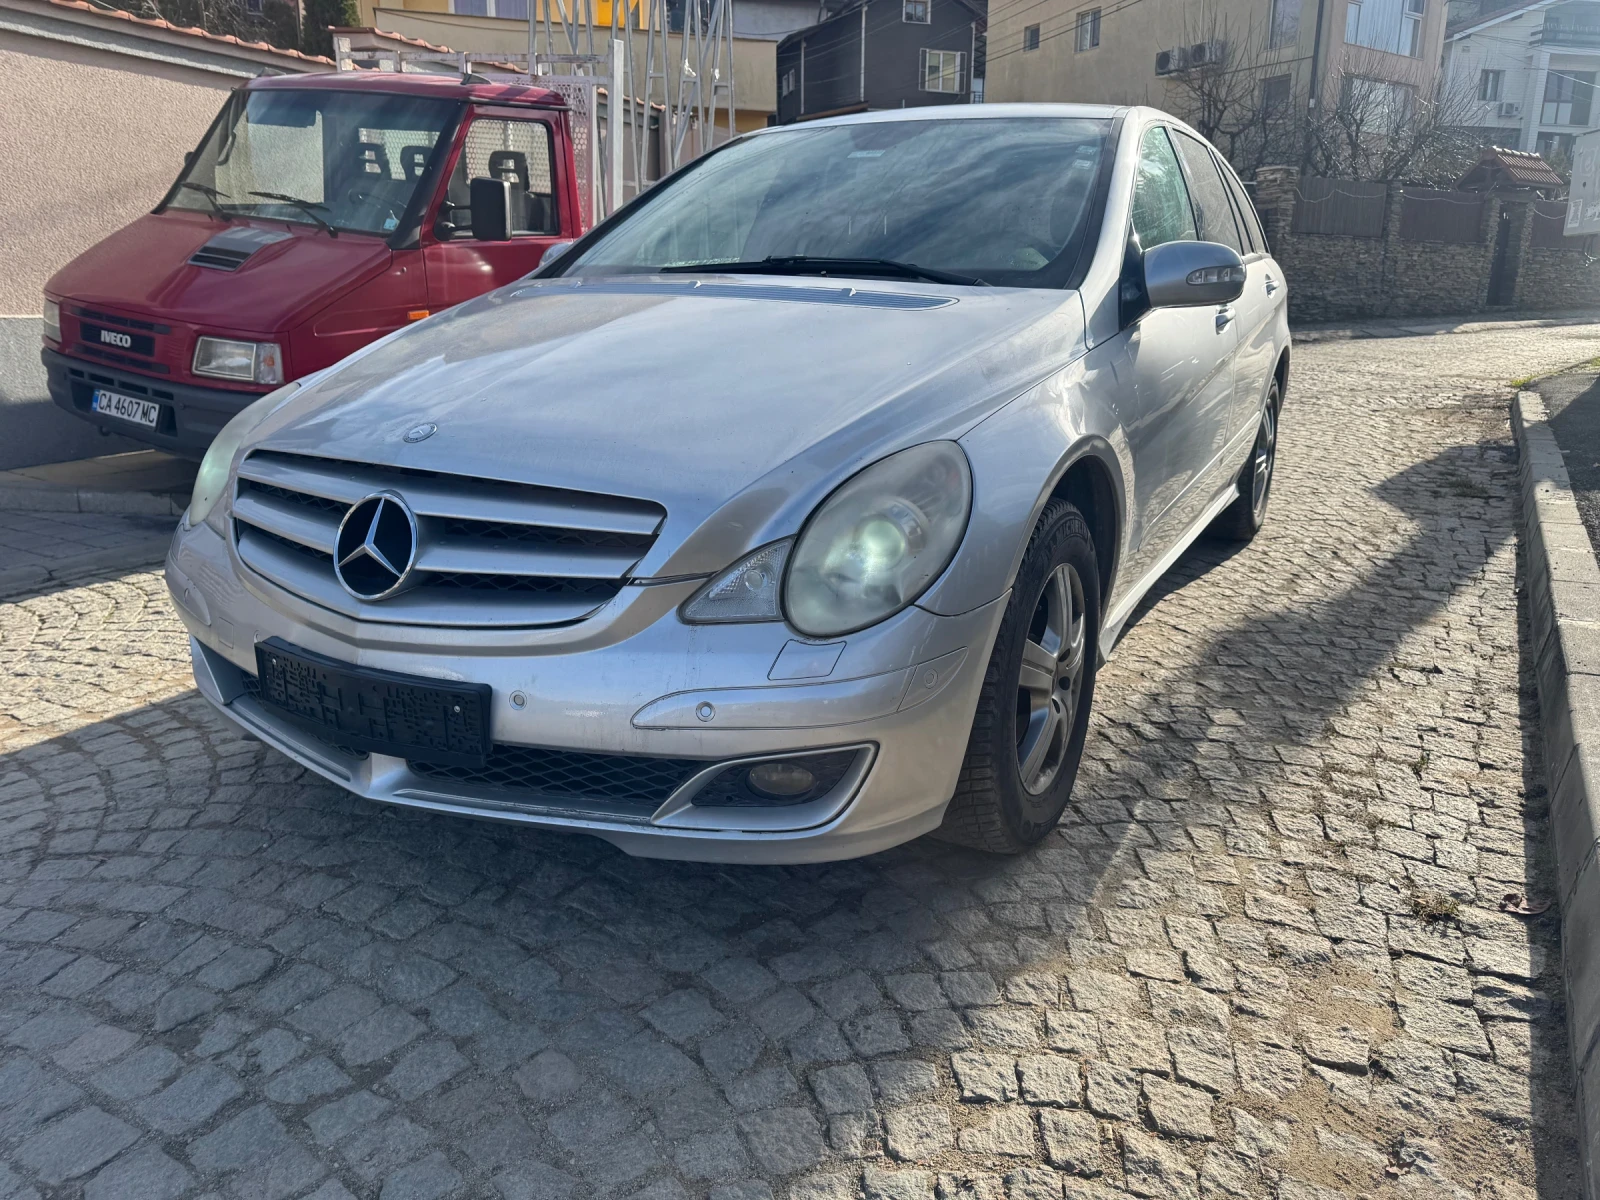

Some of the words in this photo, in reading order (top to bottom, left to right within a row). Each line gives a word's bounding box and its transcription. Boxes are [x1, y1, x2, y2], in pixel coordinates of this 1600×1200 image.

[101, 330, 131, 348] IVECO
[98, 393, 112, 413] CA
[114, 397, 141, 419] 4607
[140, 404, 157, 424] MC
[1055, 519, 1089, 545] MICHELIN
